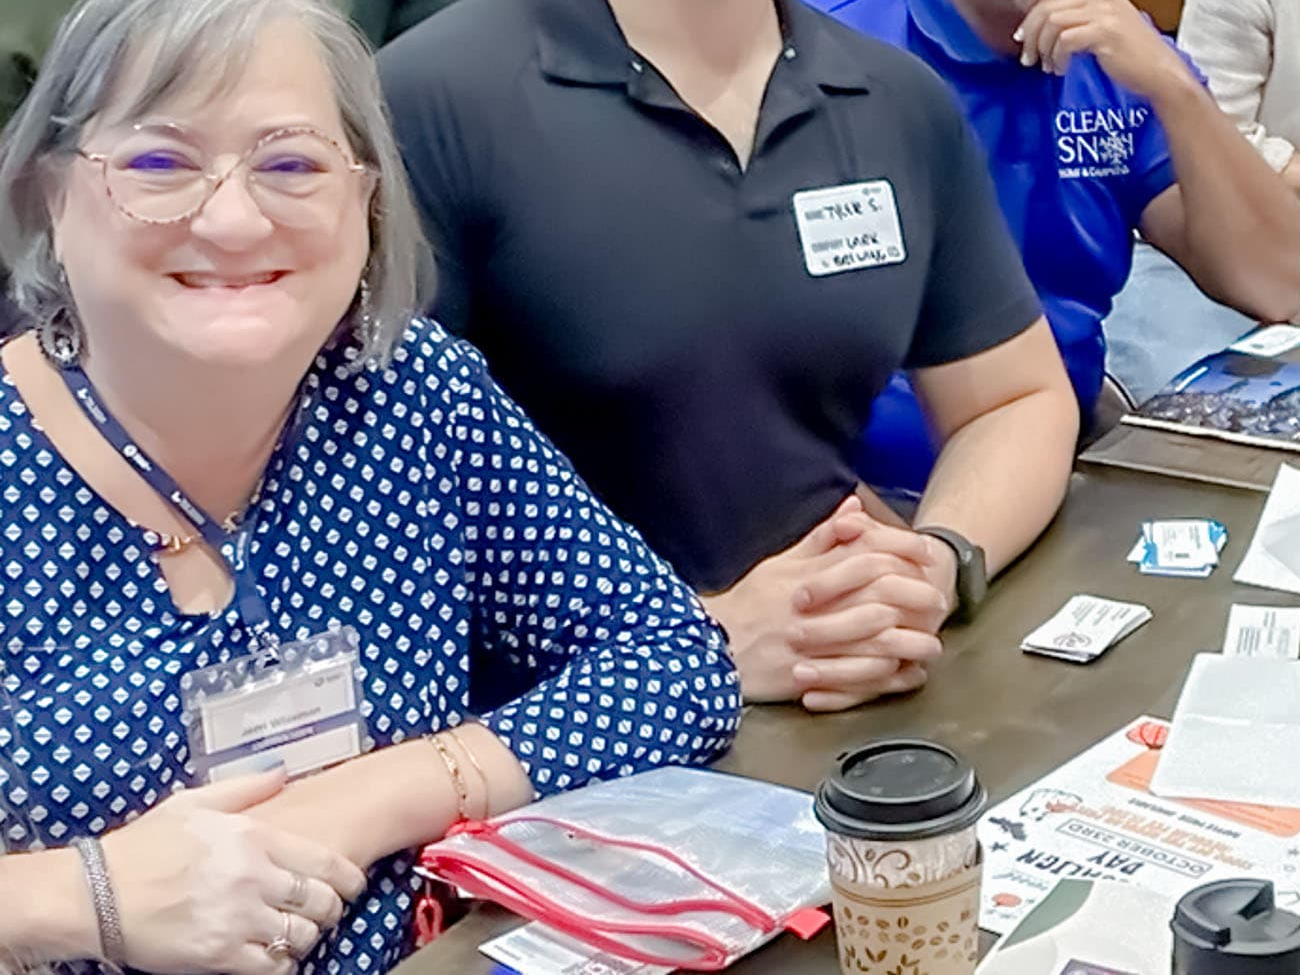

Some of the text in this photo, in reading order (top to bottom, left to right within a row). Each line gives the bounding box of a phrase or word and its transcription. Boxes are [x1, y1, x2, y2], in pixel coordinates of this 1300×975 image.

[1055, 107, 1149, 134] CLEAN IS
[1086, 850, 1145, 875] DAY
[1116, 838, 1205, 875] OCTOBER
